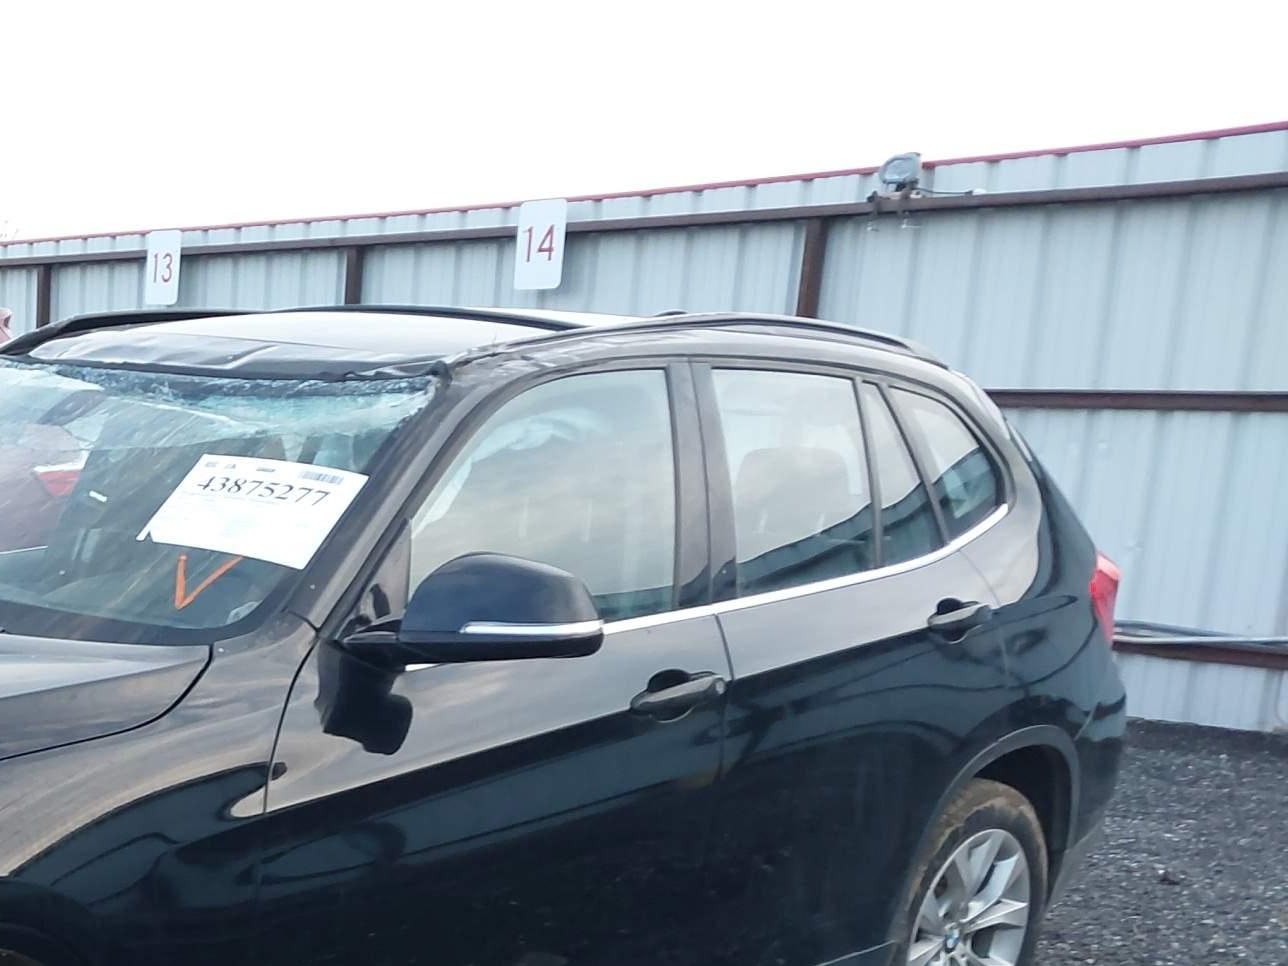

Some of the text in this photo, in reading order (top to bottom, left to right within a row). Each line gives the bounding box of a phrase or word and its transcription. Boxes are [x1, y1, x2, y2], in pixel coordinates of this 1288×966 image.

[523, 223, 556, 263] 14
[151, 252, 173, 284] 13
[196, 475, 332, 507] 43875277
